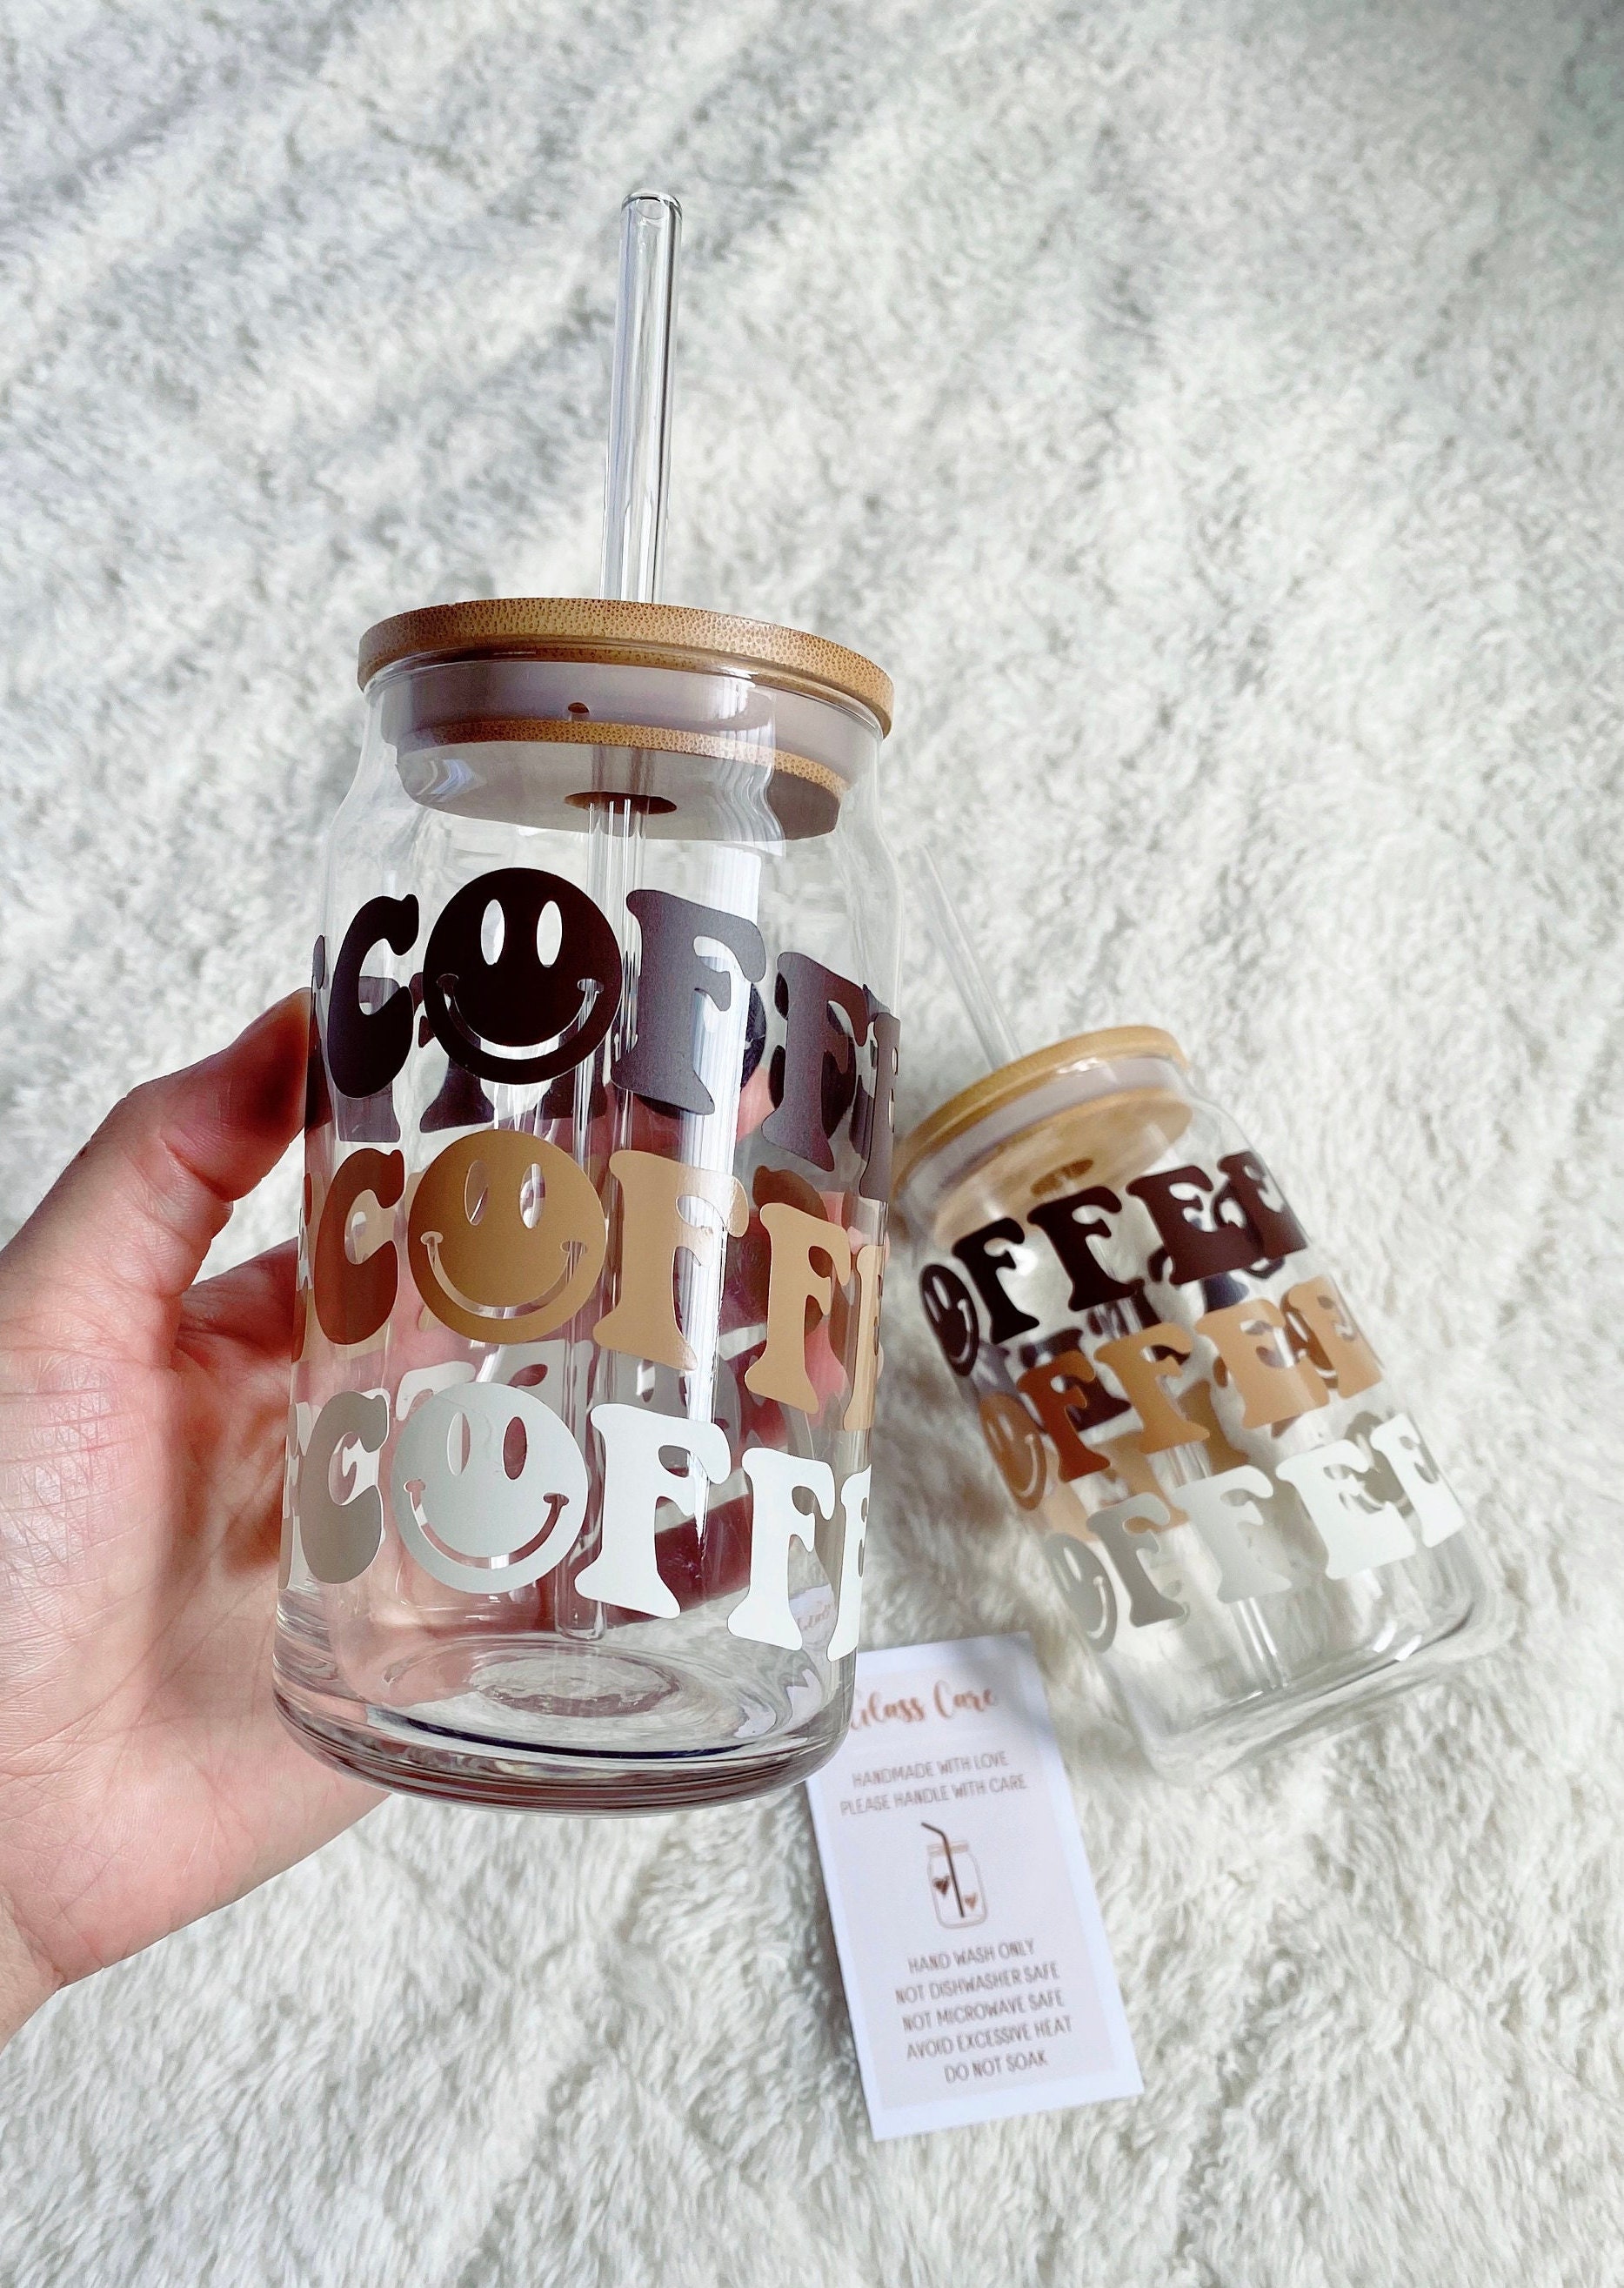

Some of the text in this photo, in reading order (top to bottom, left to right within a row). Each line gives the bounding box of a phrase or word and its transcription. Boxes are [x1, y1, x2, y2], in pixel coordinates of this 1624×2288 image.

[933, 1680, 995, 1719] Care
[852, 1750, 1009, 1788] HANDMADE WITH LOVE
[839, 1774, 1027, 1816] PLEASE HANDLE WITH CARE
[908, 1938, 1035, 1974] HAND WASH ONLY
[895, 1961, 1060, 2004] NOT DISHWASHER SAFE
[902, 1990, 1066, 2032] NOT MICROWAVE SAFE
[906, 2015, 1073, 2061] AVOID EXCESSIVE HEAT
[945, 2050, 1049, 2083] DO NOT SOAK
